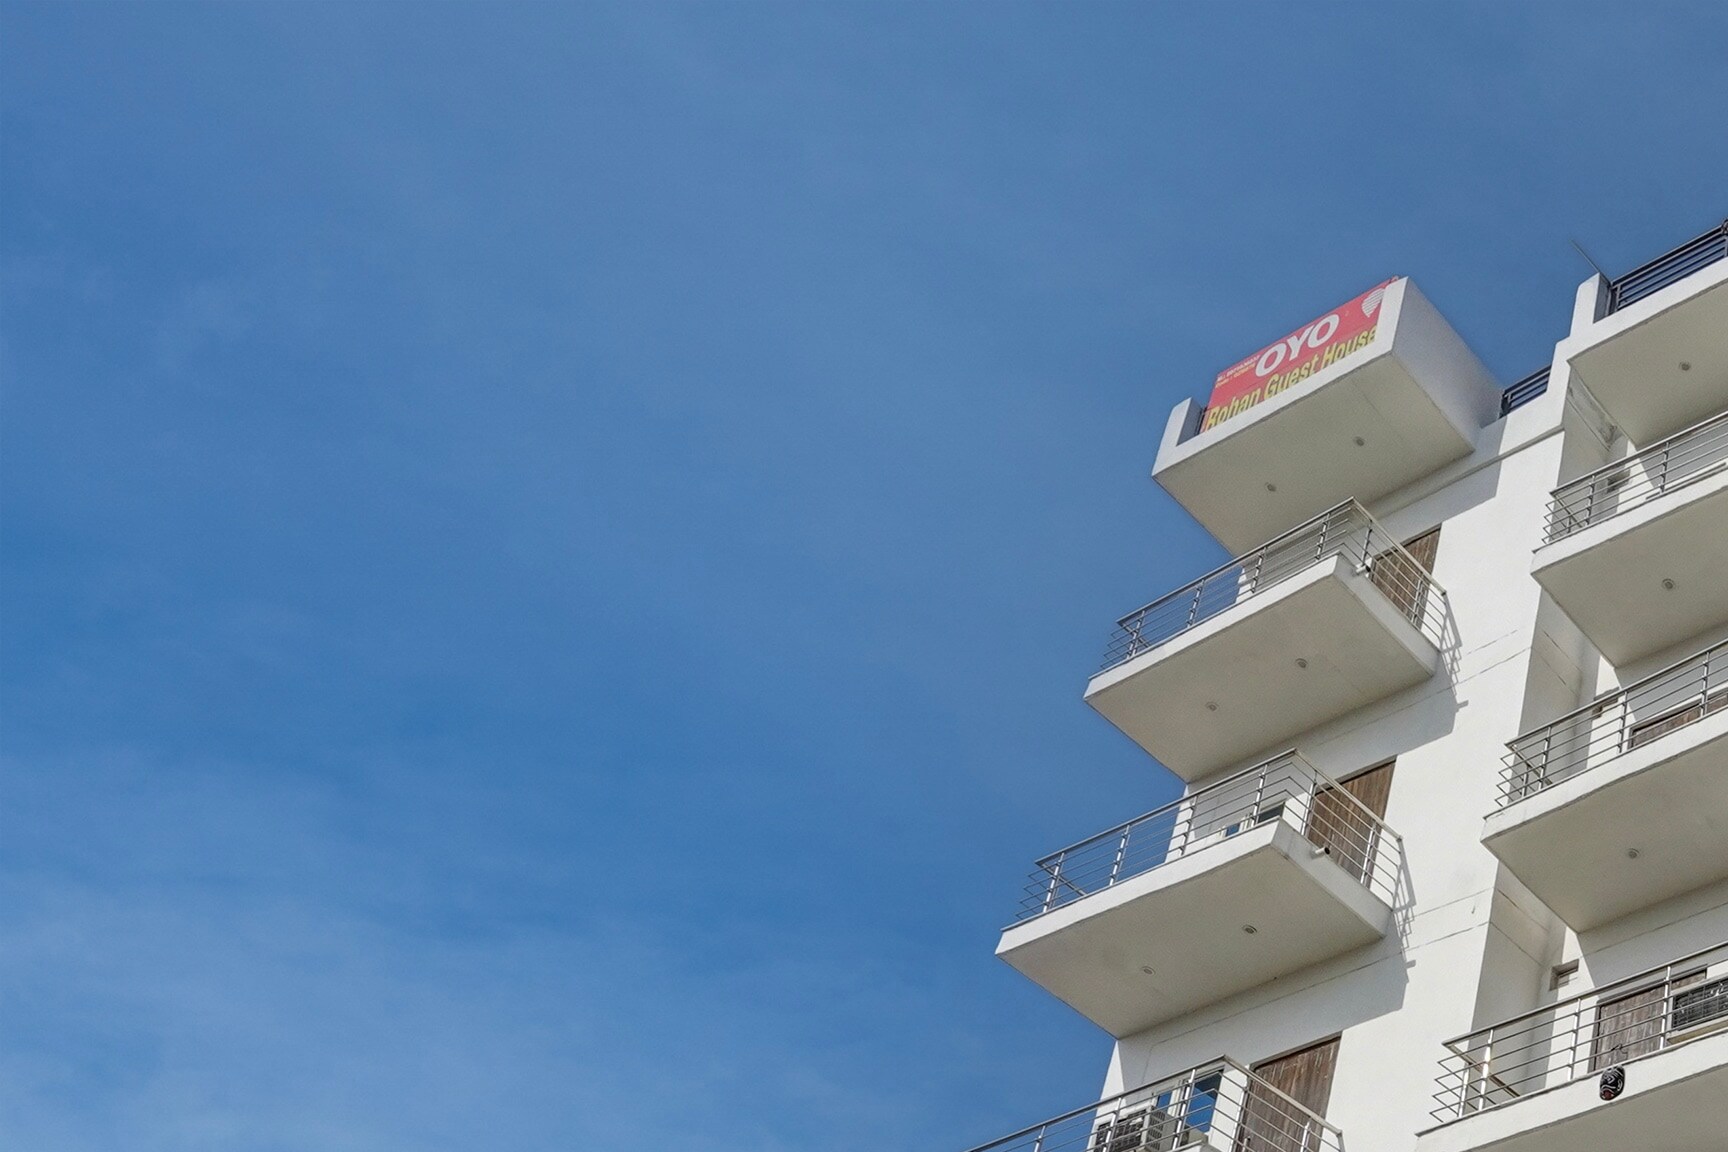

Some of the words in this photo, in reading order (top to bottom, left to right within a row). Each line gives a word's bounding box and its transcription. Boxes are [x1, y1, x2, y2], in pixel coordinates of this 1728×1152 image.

[1206, 386, 1261, 430] Rohan
[1264, 354, 1319, 398] Guest
[1320, 325, 1378, 370] House
[1255, 314, 1339, 377] OYO
